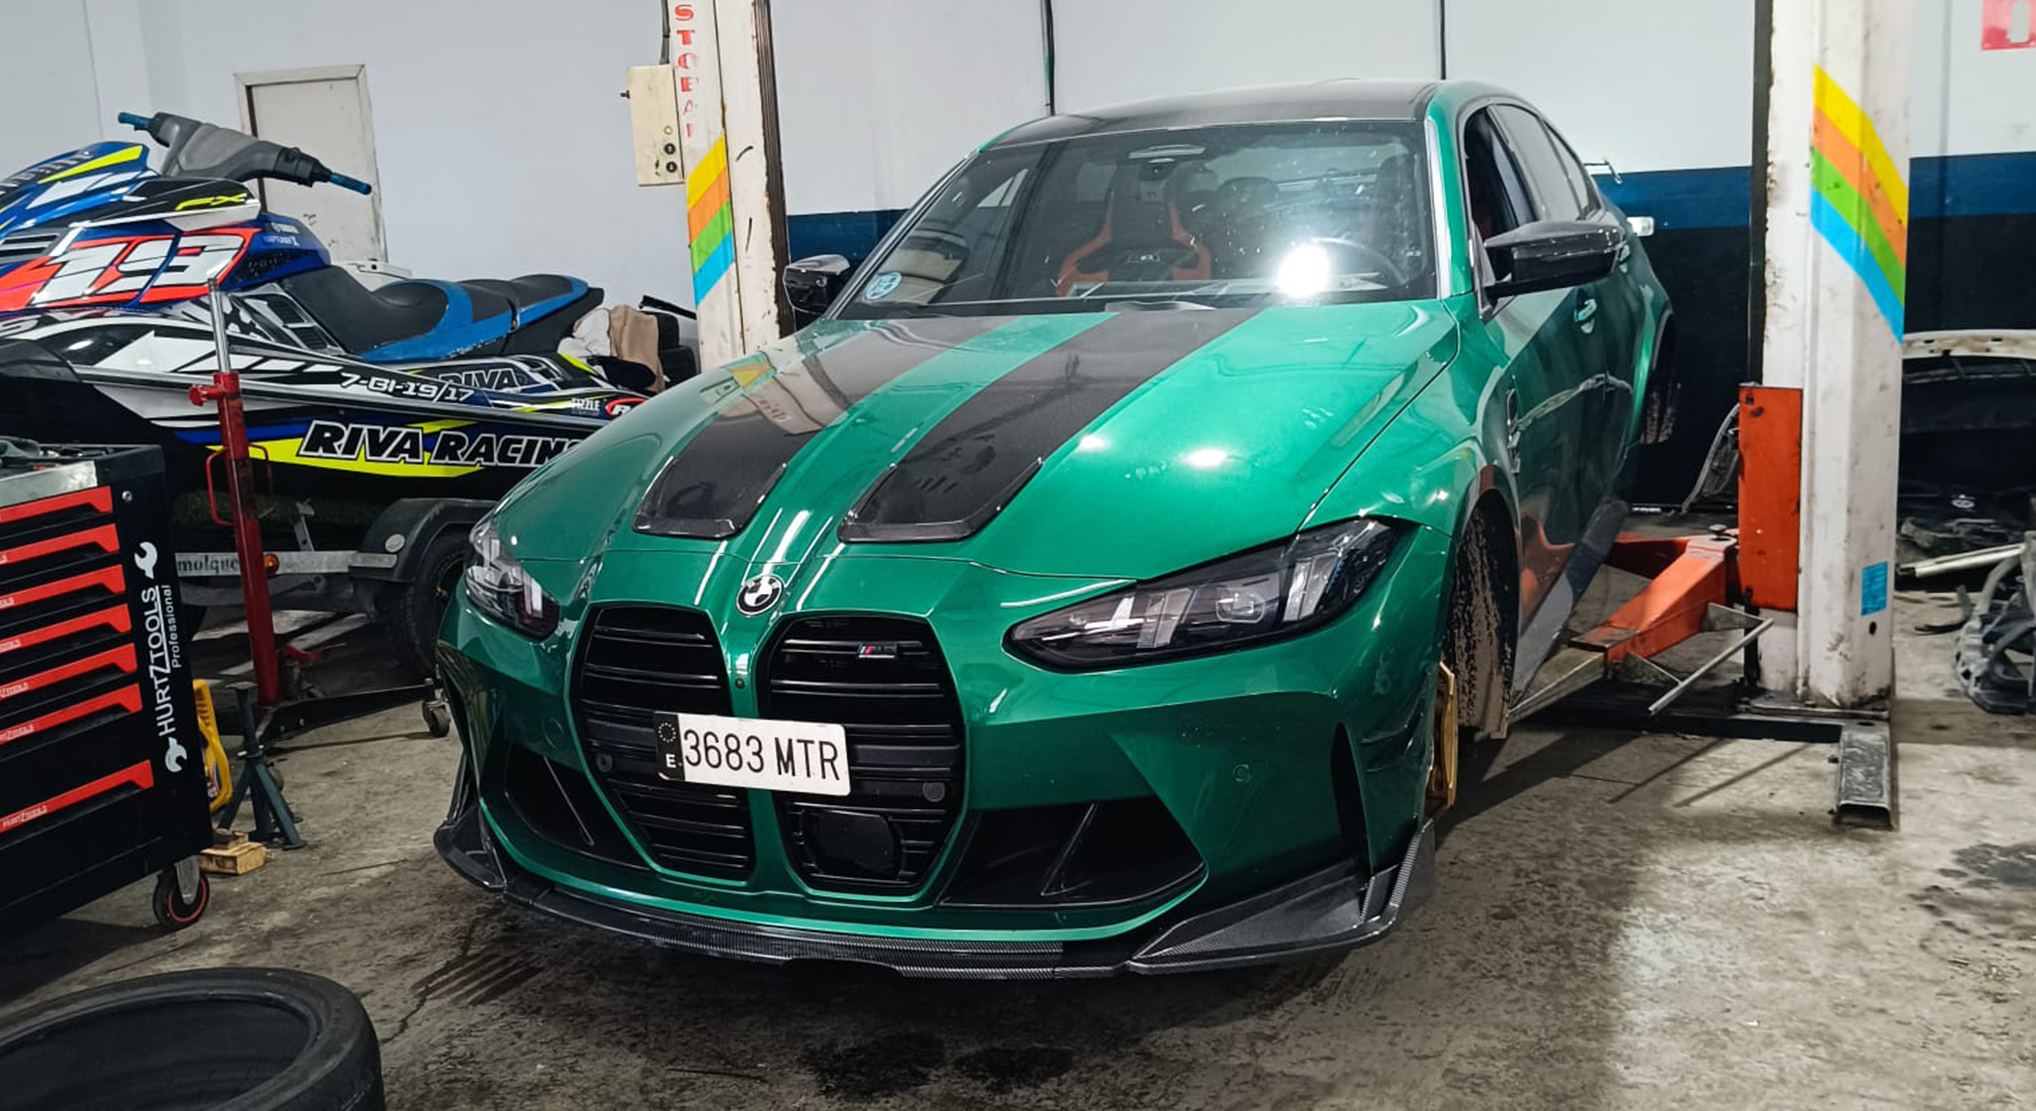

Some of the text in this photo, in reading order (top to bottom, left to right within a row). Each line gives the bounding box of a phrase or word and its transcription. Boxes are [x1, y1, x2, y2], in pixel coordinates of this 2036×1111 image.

[296, 420, 581, 468] RIVA RACIN
[161, 584, 182, 668] Professional
[141, 585, 177, 737] HURTZTOOLS
[665, 753, 677, 769] E
[683, 729, 841, 781] 3683 MTR
